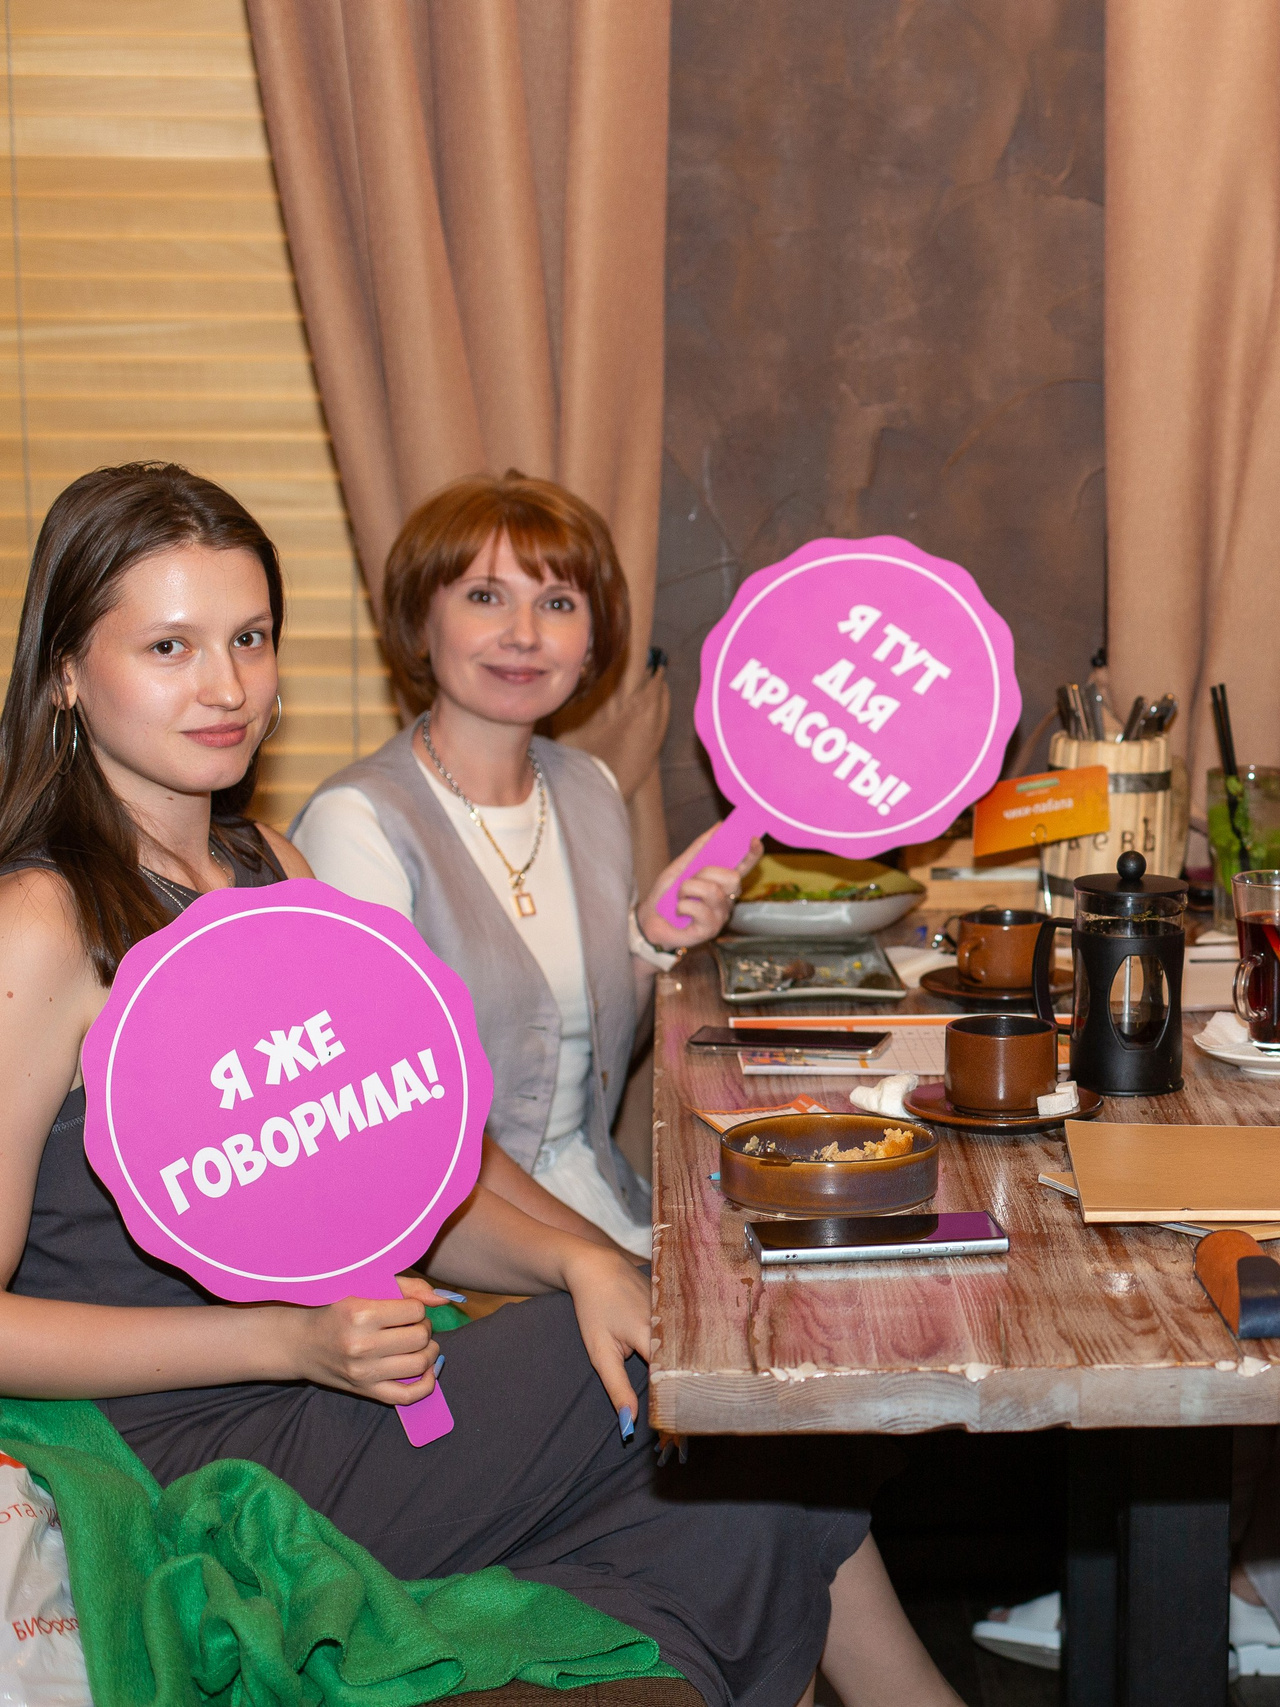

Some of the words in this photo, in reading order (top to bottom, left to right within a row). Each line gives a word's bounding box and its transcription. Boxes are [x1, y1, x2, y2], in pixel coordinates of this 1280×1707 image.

[812, 658, 900, 733] ДЛЯ
[837, 604, 882, 643] Я
[872, 623, 951, 695] ТУТ
[729, 658, 912, 816] КРАСОТЫ!
[210, 1049, 254, 1110] Я
[253, 1009, 346, 1085] ЖЕ
[159, 1048, 445, 1215] ГОВОРИЛА!
